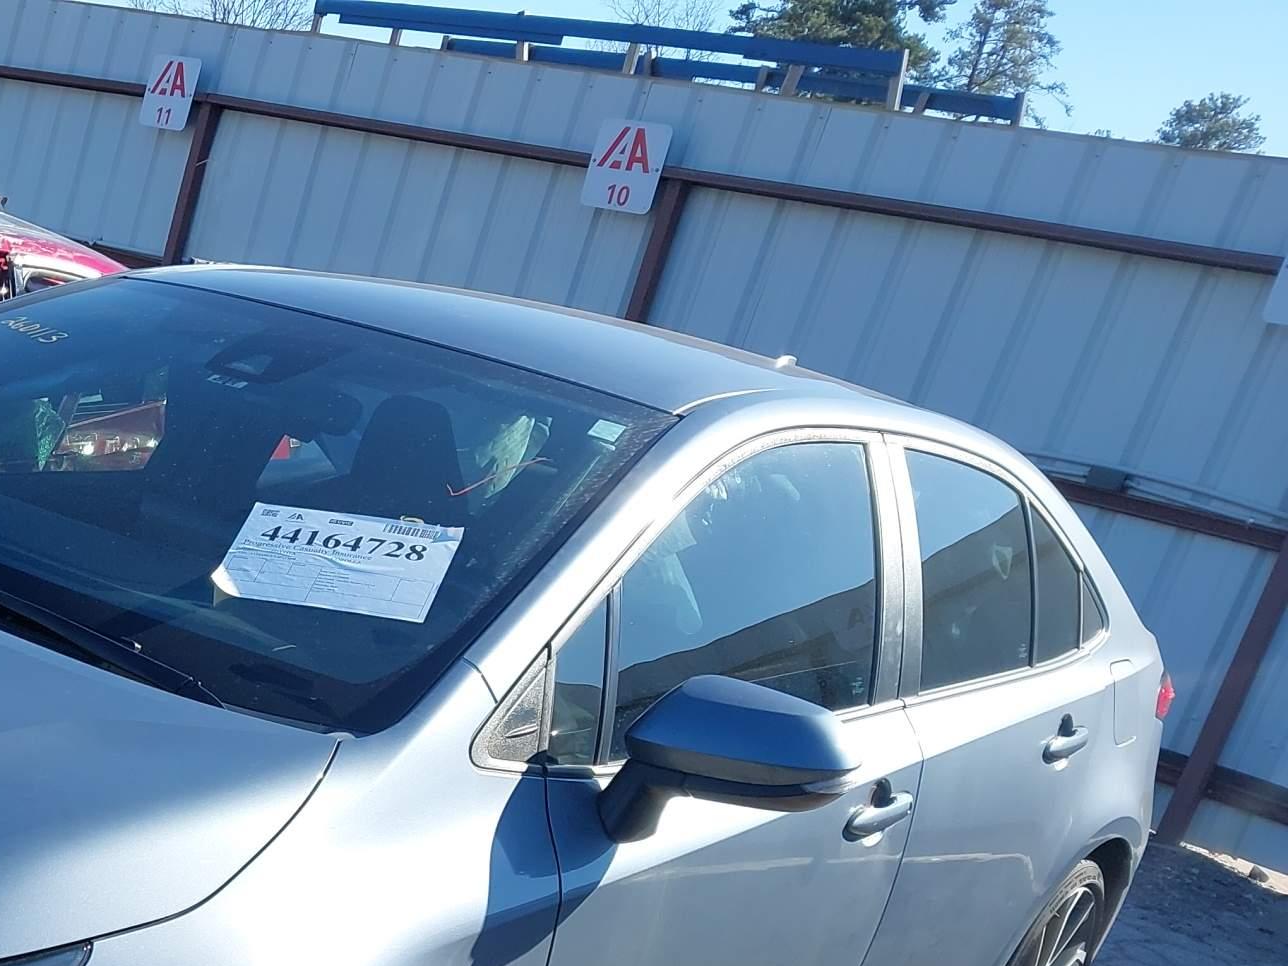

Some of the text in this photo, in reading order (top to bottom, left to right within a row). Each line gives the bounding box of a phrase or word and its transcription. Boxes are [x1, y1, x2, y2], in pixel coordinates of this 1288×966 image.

[156, 106, 172, 125] 11
[607, 184, 630, 206] 10
[242, 539, 292, 551] Progressive
[293, 545, 329, 555] Casualty
[260, 525, 428, 562] 44164728
